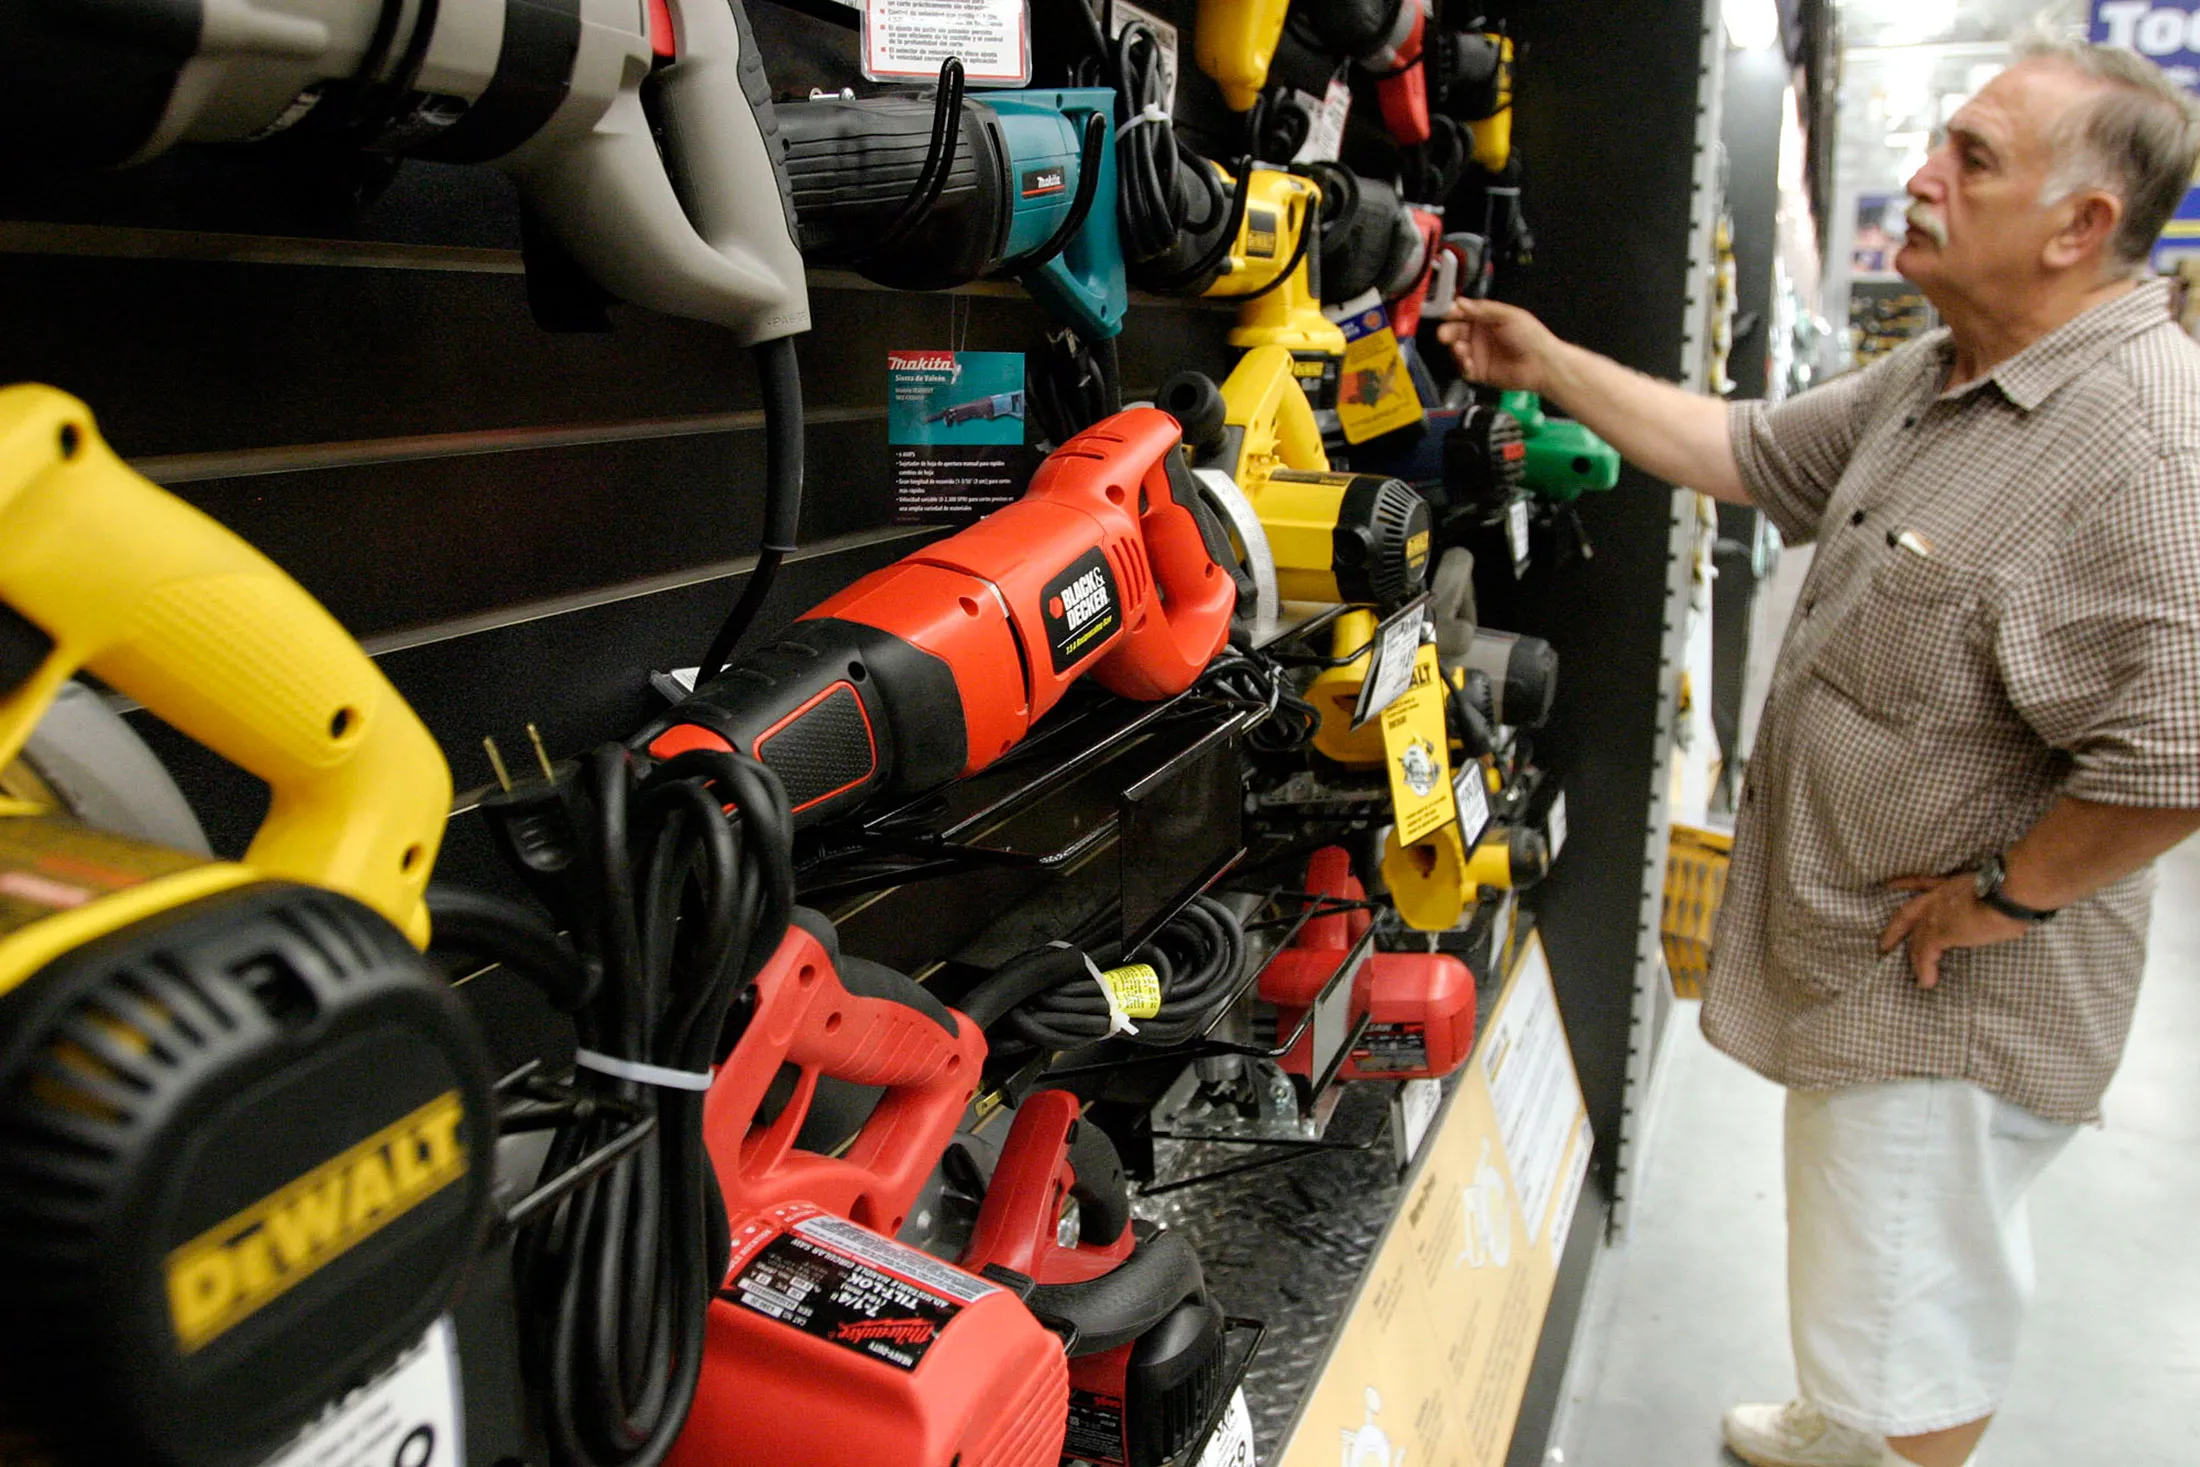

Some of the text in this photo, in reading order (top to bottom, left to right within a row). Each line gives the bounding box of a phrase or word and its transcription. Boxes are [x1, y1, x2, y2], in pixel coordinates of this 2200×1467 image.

[2097, 1, 2200, 56] To
[895, 374, 914, 382] Sierra
[1066, 586, 1109, 632] DECKER
[790, 1238, 812, 1252] SAW
[812, 1246, 856, 1270] CIRCULAR
[854, 1265, 891, 1284] HANDLE
[848, 1273, 919, 1310] TILT-LOK
[890, 1278, 950, 1308] ADJUSTABLE
[838, 1321, 936, 1346] Milwaukee
